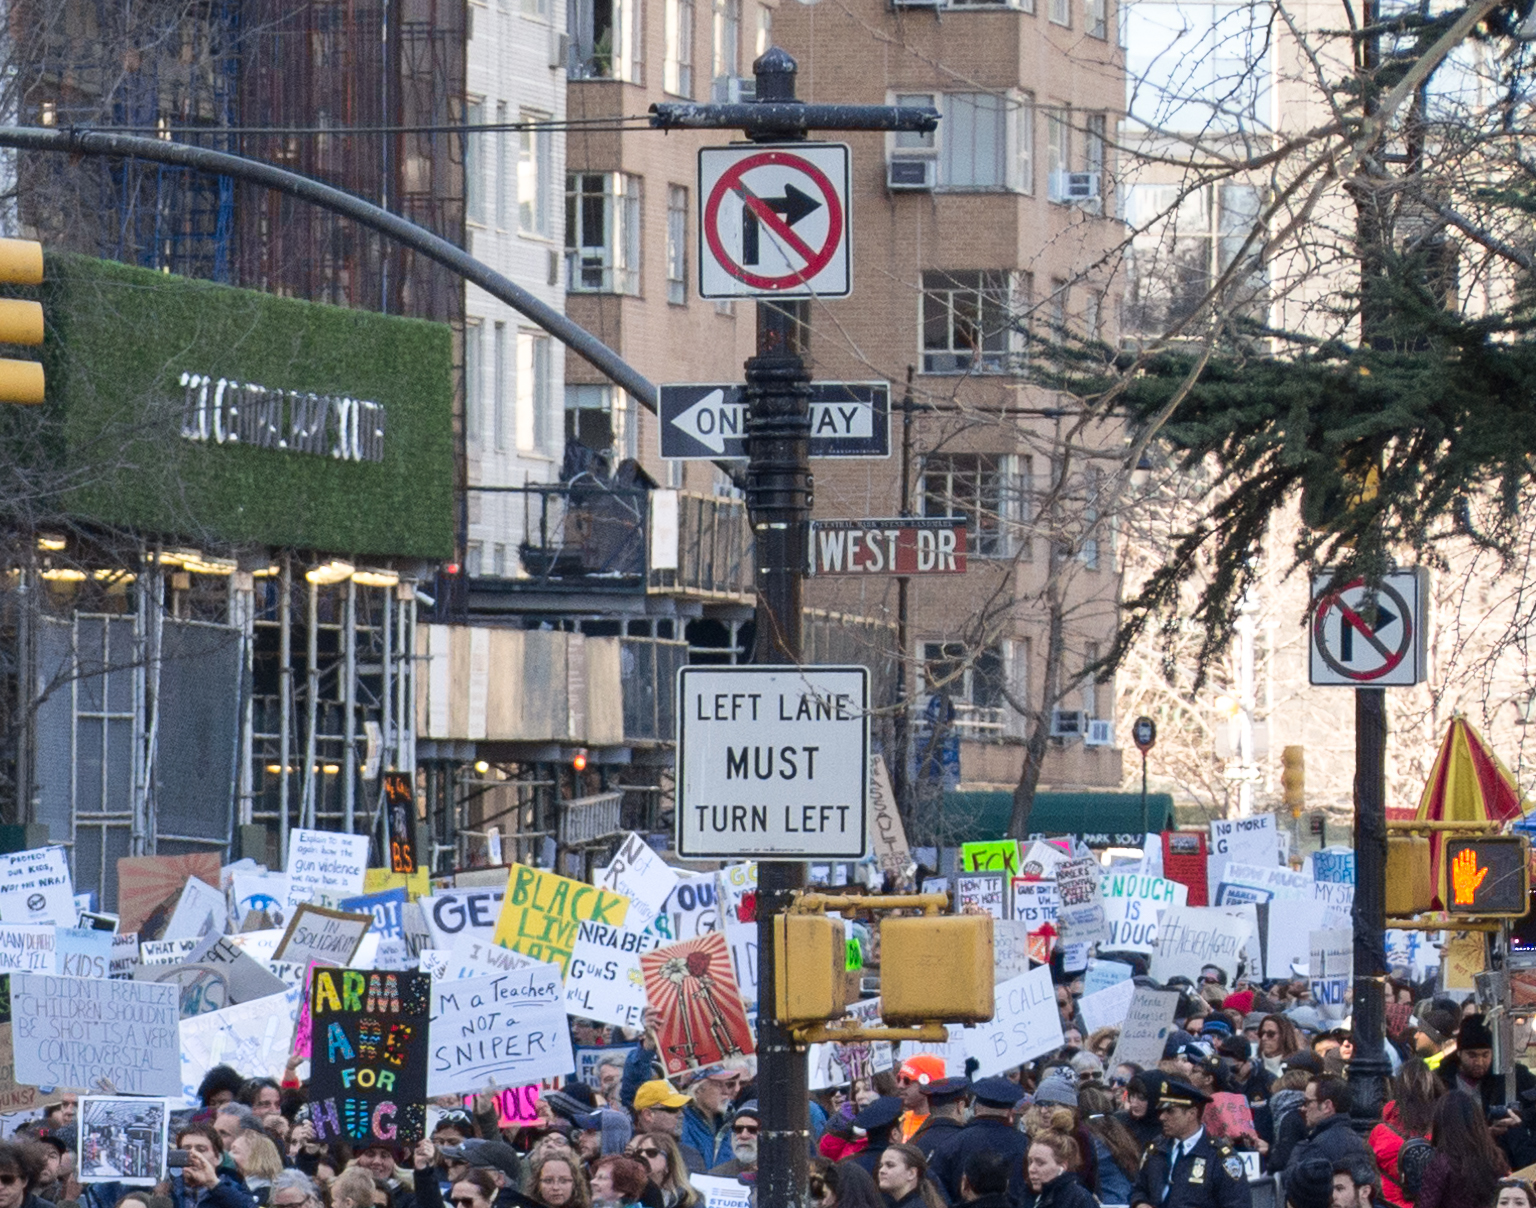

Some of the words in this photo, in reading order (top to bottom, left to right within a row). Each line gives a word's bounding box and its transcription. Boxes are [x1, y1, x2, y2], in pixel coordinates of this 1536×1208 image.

[820, 530, 900, 571] WEST
[917, 530, 957, 571] DR
[697, 694, 761, 720] LEFT
[780, 694, 850, 720] LANE
[727, 747, 819, 780] MUST
[696, 805, 767, 833] TURN
[785, 805, 849, 833] LEFT
[1216, 824, 1232, 837] NO
[1236, 818, 1269, 833] MORE
[295, 861, 317, 873] gun
[319, 858, 361, 876] violence
[513, 867, 622, 927] BLACK
[1101, 877, 1175, 903] ENOUGH
[1126, 901, 1140, 920] IS
[63, 954, 105, 979] KIDS
[572, 959, 617, 980] GUNS
[110, 983, 175, 1007] REALIZE
[471, 995, 484, 1007] a
[1009, 981, 1052, 1015] CALL
[19, 1018, 39, 1039] BE
[143, 1027, 175, 1049] VERY
[461, 1013, 502, 1038] NOT
[506, 1017, 520, 1028] a
[38, 1040, 163, 1071] CONTROVERSIAL
[327, 1018, 412, 1066] ARE
[435, 1032, 558, 1072] SNIPER!
[47, 1064, 148, 1092] STATEMENT
[341, 1067, 397, 1094] FOR
[310, 1097, 427, 1142] HUGS
